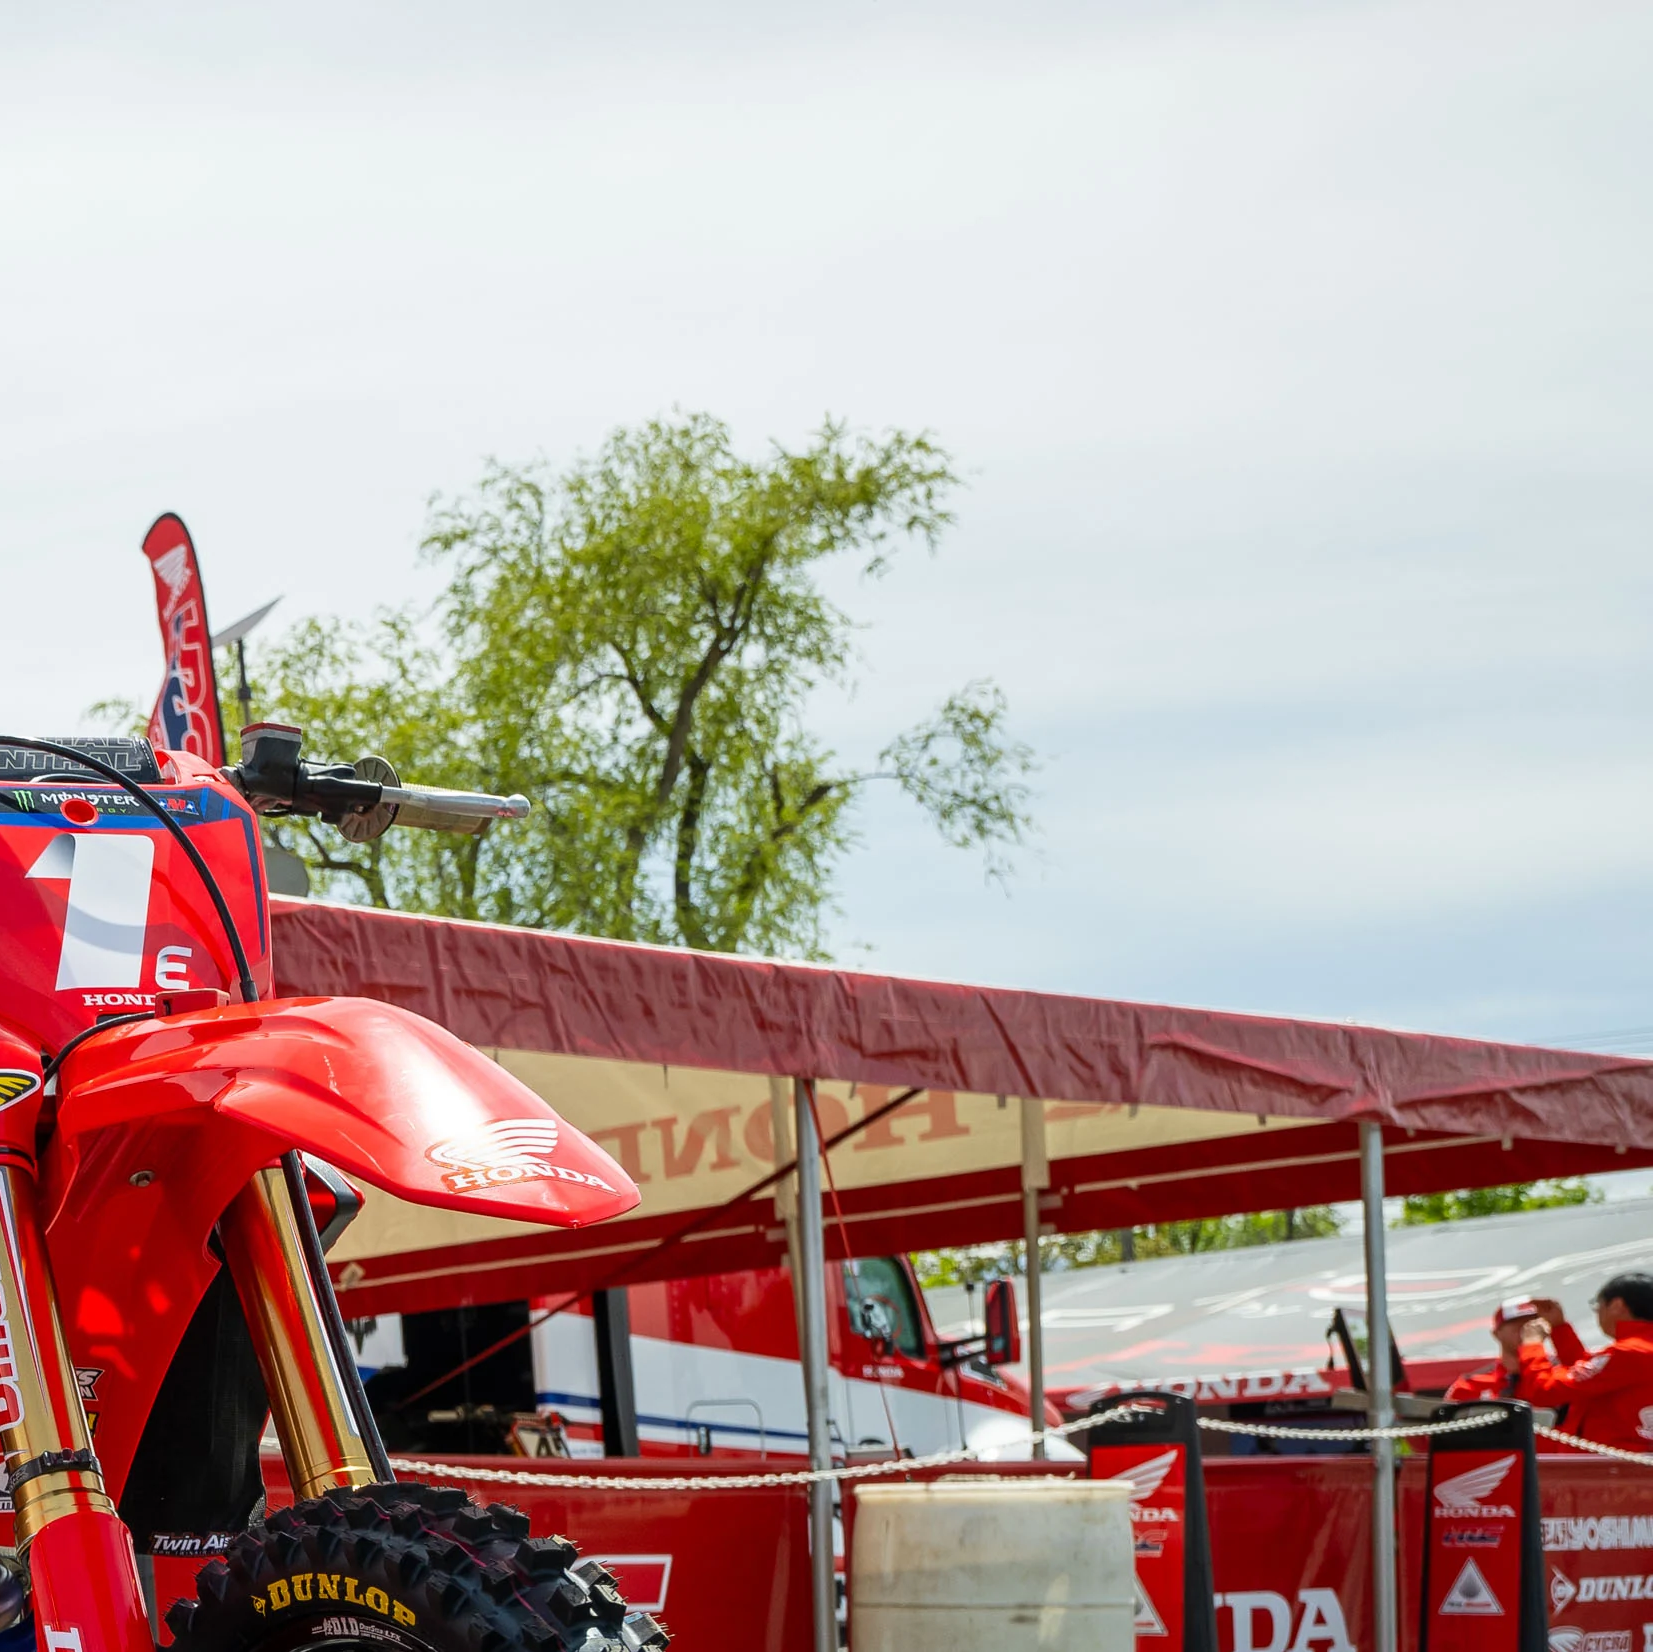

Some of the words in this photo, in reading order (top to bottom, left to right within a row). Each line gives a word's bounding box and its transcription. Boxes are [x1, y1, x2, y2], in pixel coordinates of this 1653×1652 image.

[25, 833, 155, 992] 1
[155, 945, 192, 990] E
[82, 993, 155, 1006] HON
[448, 1164, 618, 1192] HONDA
[1131, 1506, 1179, 1522] NDA
[1434, 1505, 1516, 1518] HONDA
[153, 1534, 205, 1551] Twin
[206, 1534, 233, 1549] Air
[267, 1573, 416, 1627] DUNLOP
